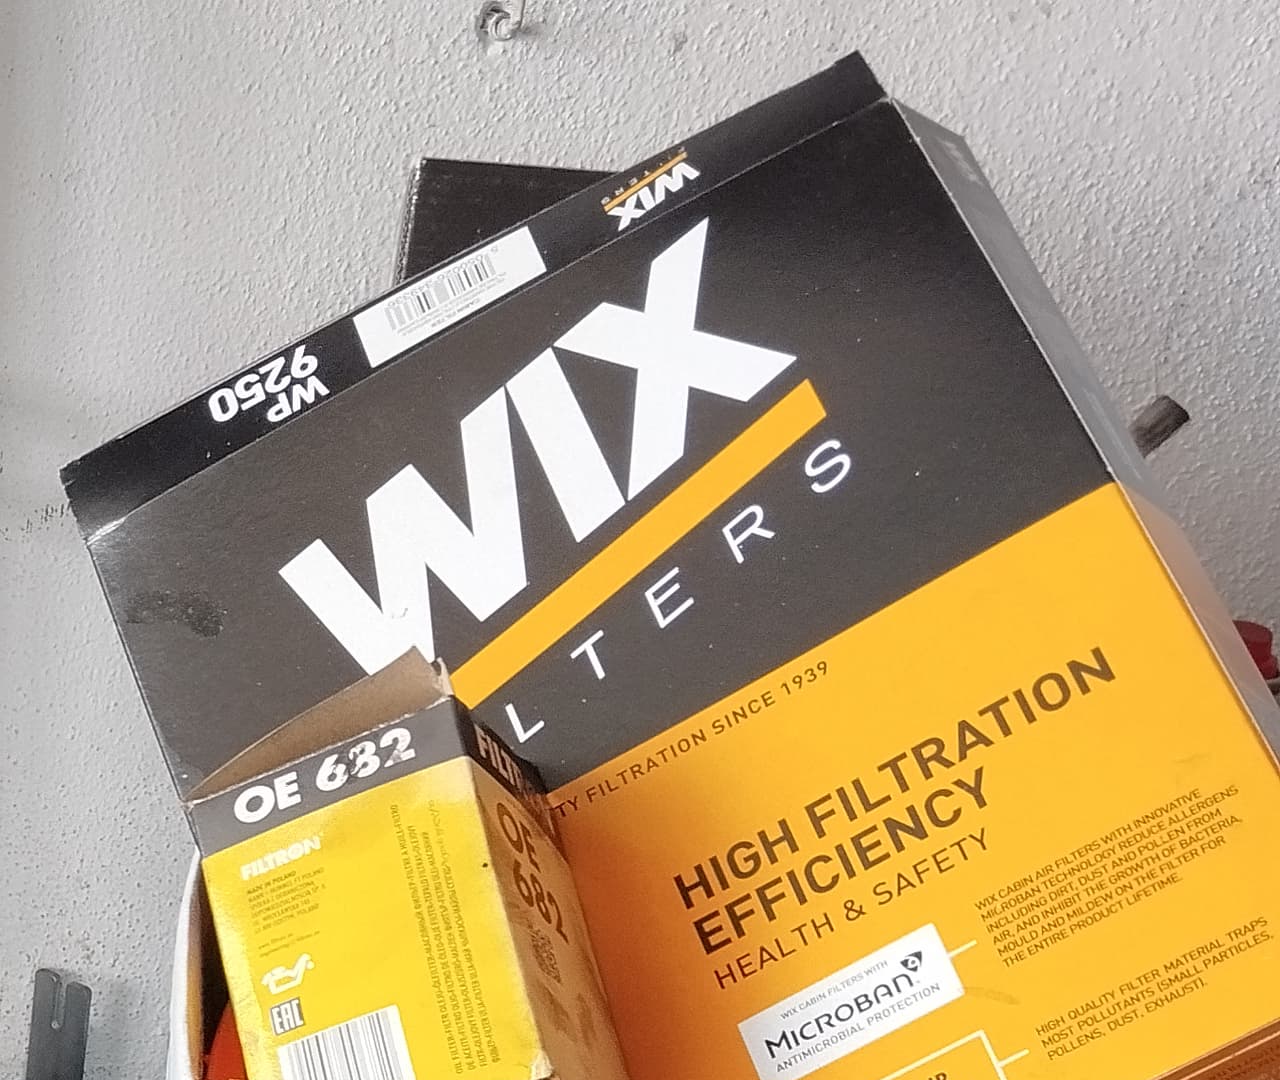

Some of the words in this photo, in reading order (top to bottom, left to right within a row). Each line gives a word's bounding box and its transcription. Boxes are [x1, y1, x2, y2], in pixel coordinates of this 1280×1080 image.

[606, 162, 701, 232] WIX
[207, 343, 319, 423] 9250
[265, 371, 331, 423] WP
[279, 217, 797, 676] WIX
[505, 440, 853, 743] LTERS
[234, 770, 302, 823] OE
[315, 727, 416, 792] 682
[585, 728, 707, 803] FILTRATION
[711, 691, 776, 735] SINCE
[780, 661, 828, 697] 1939
[673, 818, 800, 909] HIGH
[804, 646, 1117, 839] FILTRATION
[240, 835, 321, 880] FILTRON
[496, 802, 541, 874] OE
[692, 765, 990, 955] EFFICIENCY
[975, 894, 997, 910] WIX
[999, 875, 1033, 898] CABIN
[1035, 864, 1054, 880] AIR
[1056, 840, 1101, 869] FILTERS
[1103, 824, 1132, 845] WITH
[1134, 789, 1201, 828] INNOVATIVE
[982, 886, 1040, 921] MICROBAN
[1044, 847, 1117, 889] TECHNOLOGY
[1120, 822, 1165, 850] REDUCE
[1167, 785, 1238, 826] ALLERGENS
[987, 897, 1047, 933] INCLUDING
[1079, 866, 1108, 886] DUST
[1113, 851, 1137, 869] AND
[1139, 827, 1185, 856] POLLEN
[1187, 808, 1222, 831] FROM
[513, 859, 569, 945] 682
[714, 913, 835, 989] HEALTH
[844, 899, 867, 922] &
[872, 827, 990, 906] SAFETY
[996, 930, 1038, 957] MOULD
[1038, 915, 1066, 936] AND
[1067, 891, 1114, 921] MILDEW
[1116, 882, 1133, 896] ON
[1136, 869, 1157, 886] THE
[1160, 848, 1199, 873] FILTER
[1202, 835, 1225, 852] FOR
[1002, 949, 1028, 968] THE
[1026, 928, 1070, 956] ENTIRE
[1070, 900, 1124, 934] PRODUCT
[1014, 914, 1041, 934] AND
[1042, 894, 1082, 920] INHIBIT
[1086, 881, 1107, 897] THE
[1109, 853, 1161, 886] GROWTH
[1163, 845, 1177, 858] OF
[779, 1005, 798, 1020] WIX
[797, 991, 826, 1011] CABIN
[826, 972, 864, 996] FILTERS
[863, 959, 888, 977] WITH
[1036, 1018, 1065, 1036] HIGH
[1069, 992, 1116, 1020] QUALITY
[1120, 970, 1160, 994] FILTER
[1164, 938, 1224, 972] MATERIAL
[1226, 917, 1267, 941] TRAPS
[1043, 1028, 1075, 1048] MOST
[1078, 988, 1155, 1031] POLLUTANTS
[774, 1020, 864, 1073] ANTIMICROBIAL
[865, 981, 941, 1026] PROTECTION
